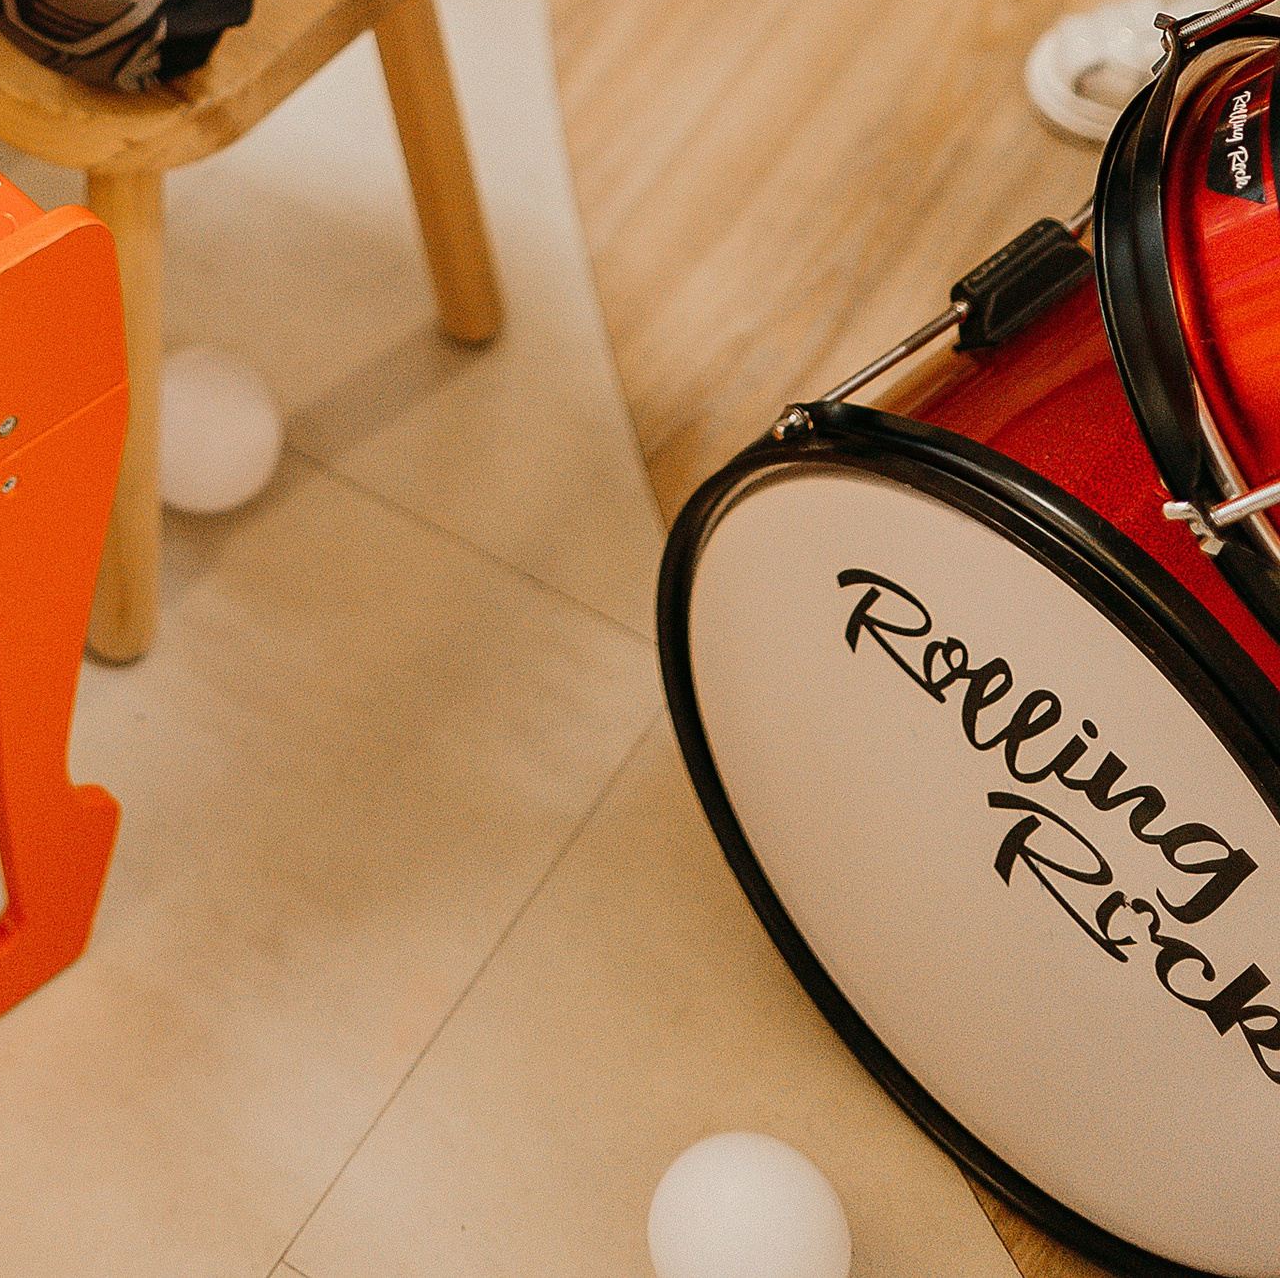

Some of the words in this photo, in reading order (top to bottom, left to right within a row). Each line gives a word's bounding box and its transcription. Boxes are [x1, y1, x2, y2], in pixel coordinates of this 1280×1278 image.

[1225, 90, 1251, 143] Rolling
[1227, 146, 1251, 189] Rock
[837, 569, 1259, 924] Rolling
[987, 791, 1280, 1085] Rock
